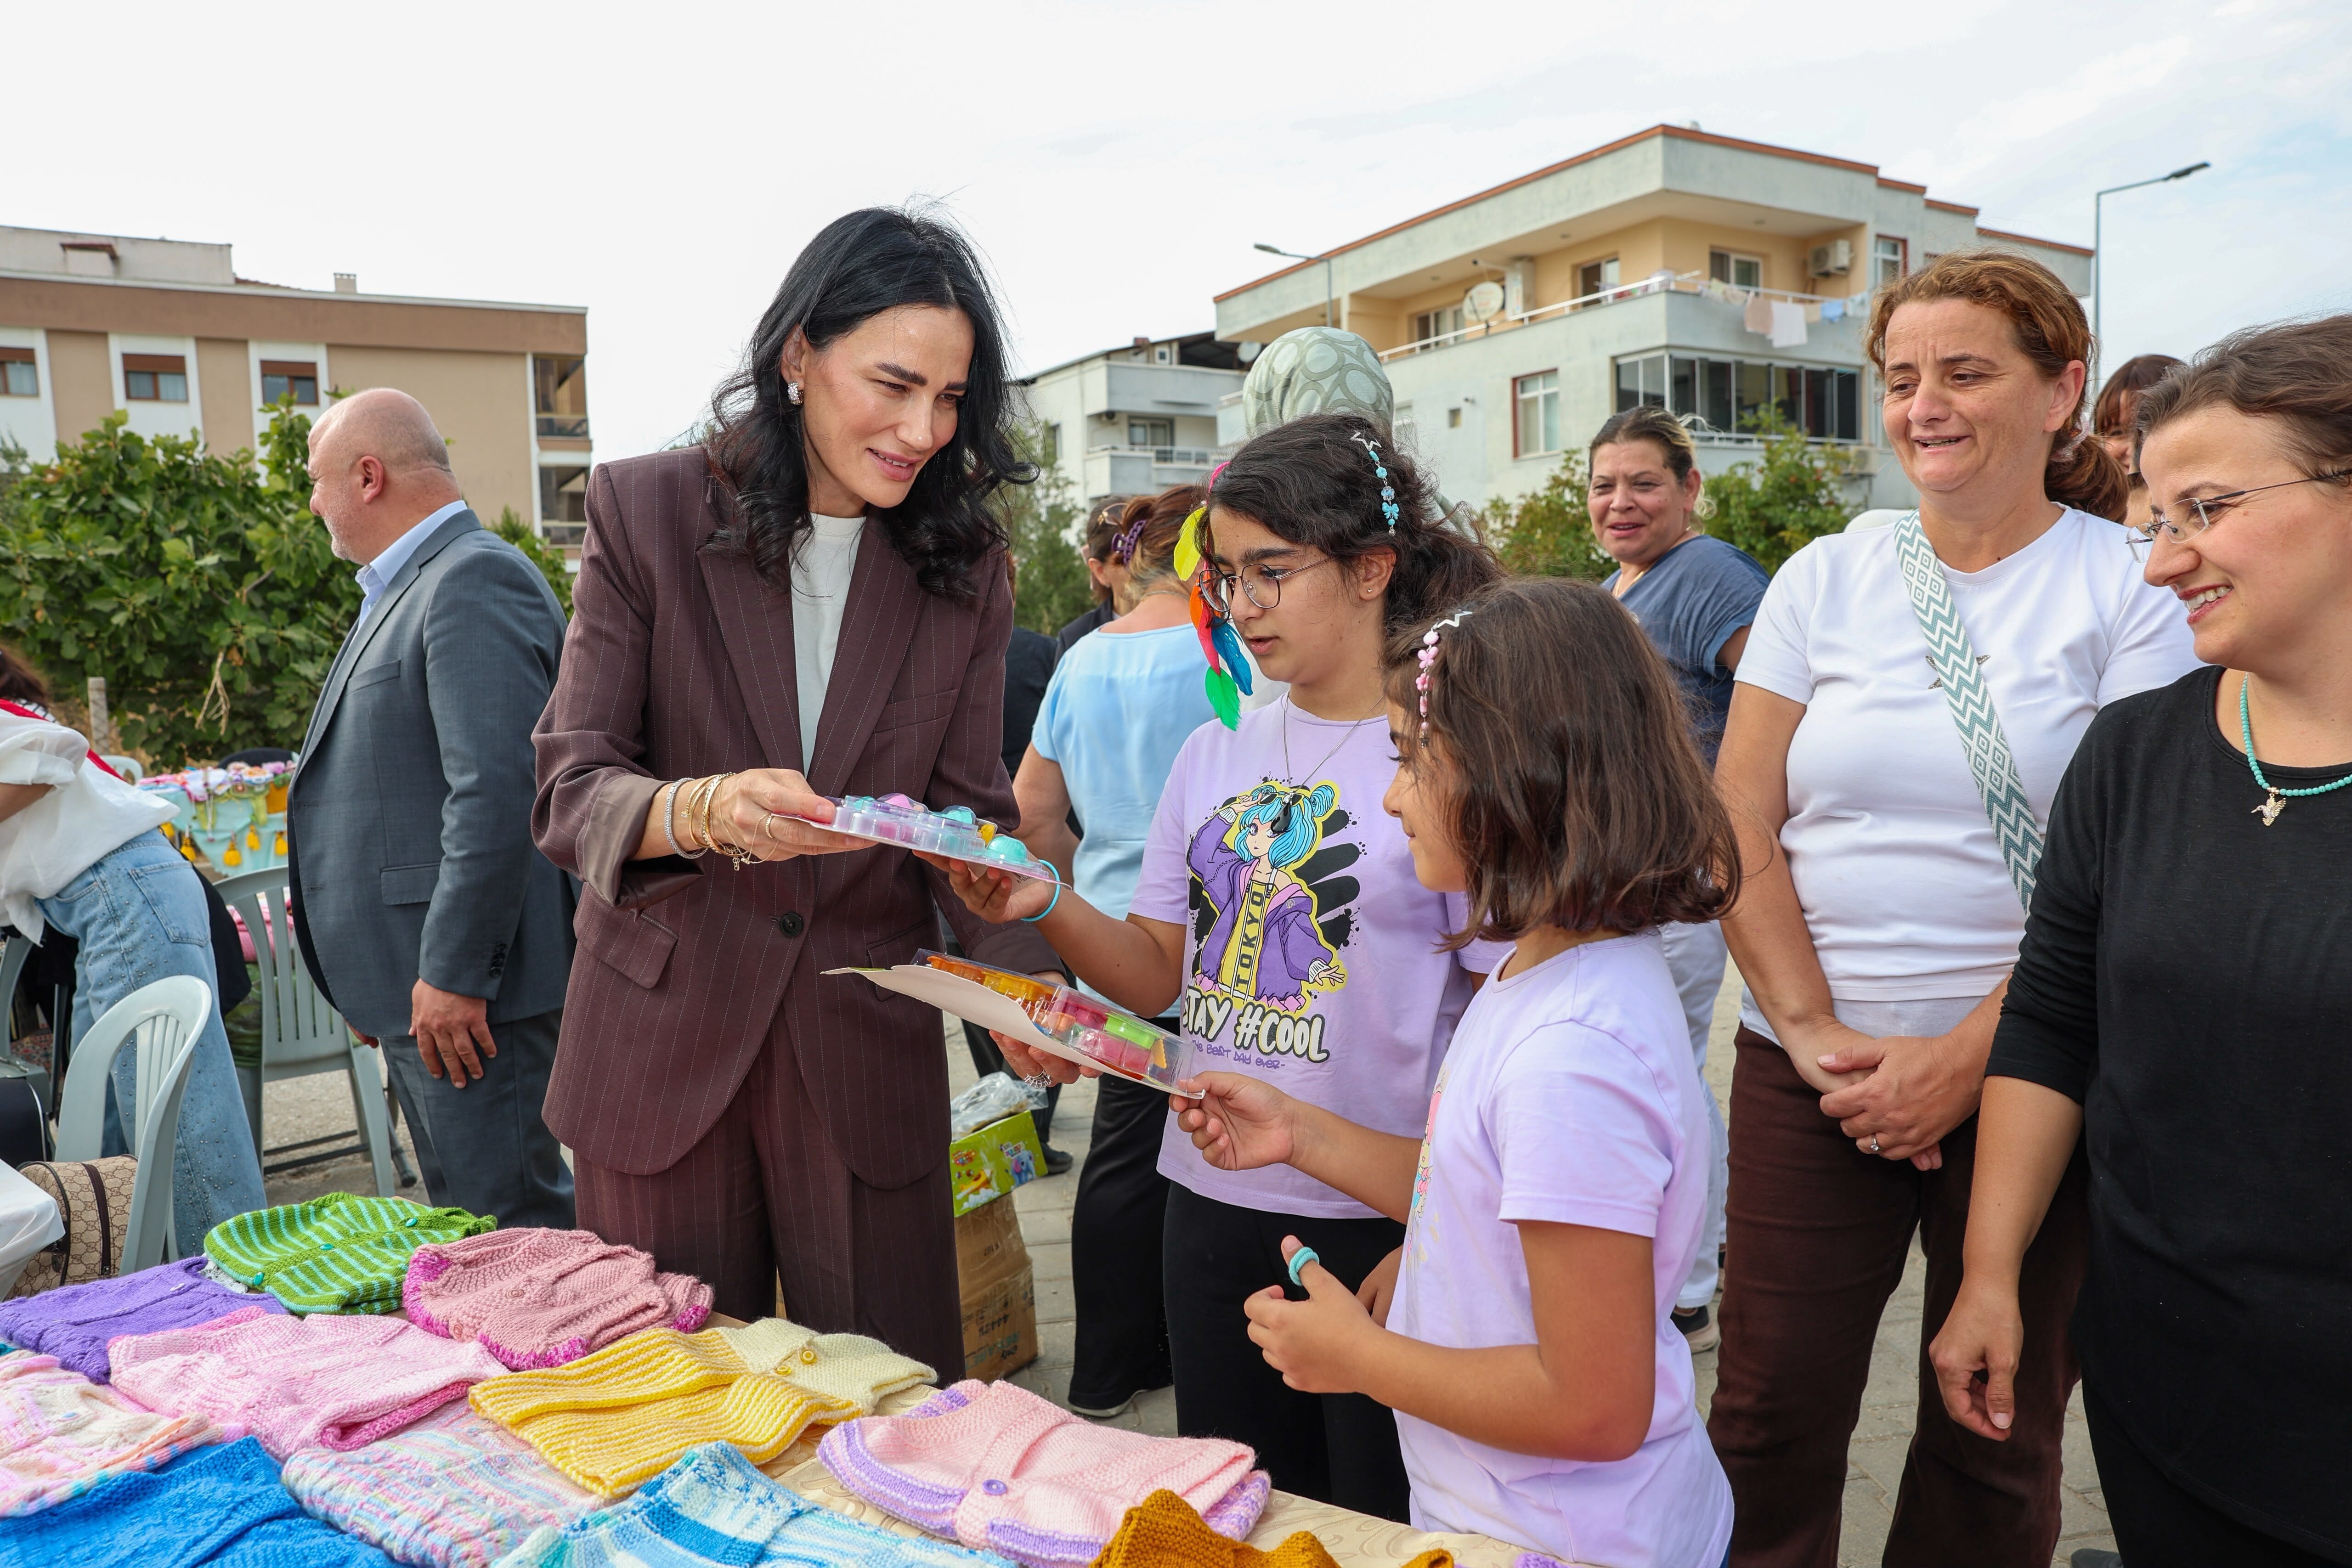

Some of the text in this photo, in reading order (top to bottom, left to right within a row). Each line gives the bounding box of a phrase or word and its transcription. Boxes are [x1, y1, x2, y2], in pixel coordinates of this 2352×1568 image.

[1236, 890, 1264, 987] TOKYO
[1183, 985, 1330, 1063] STAY #COOL
